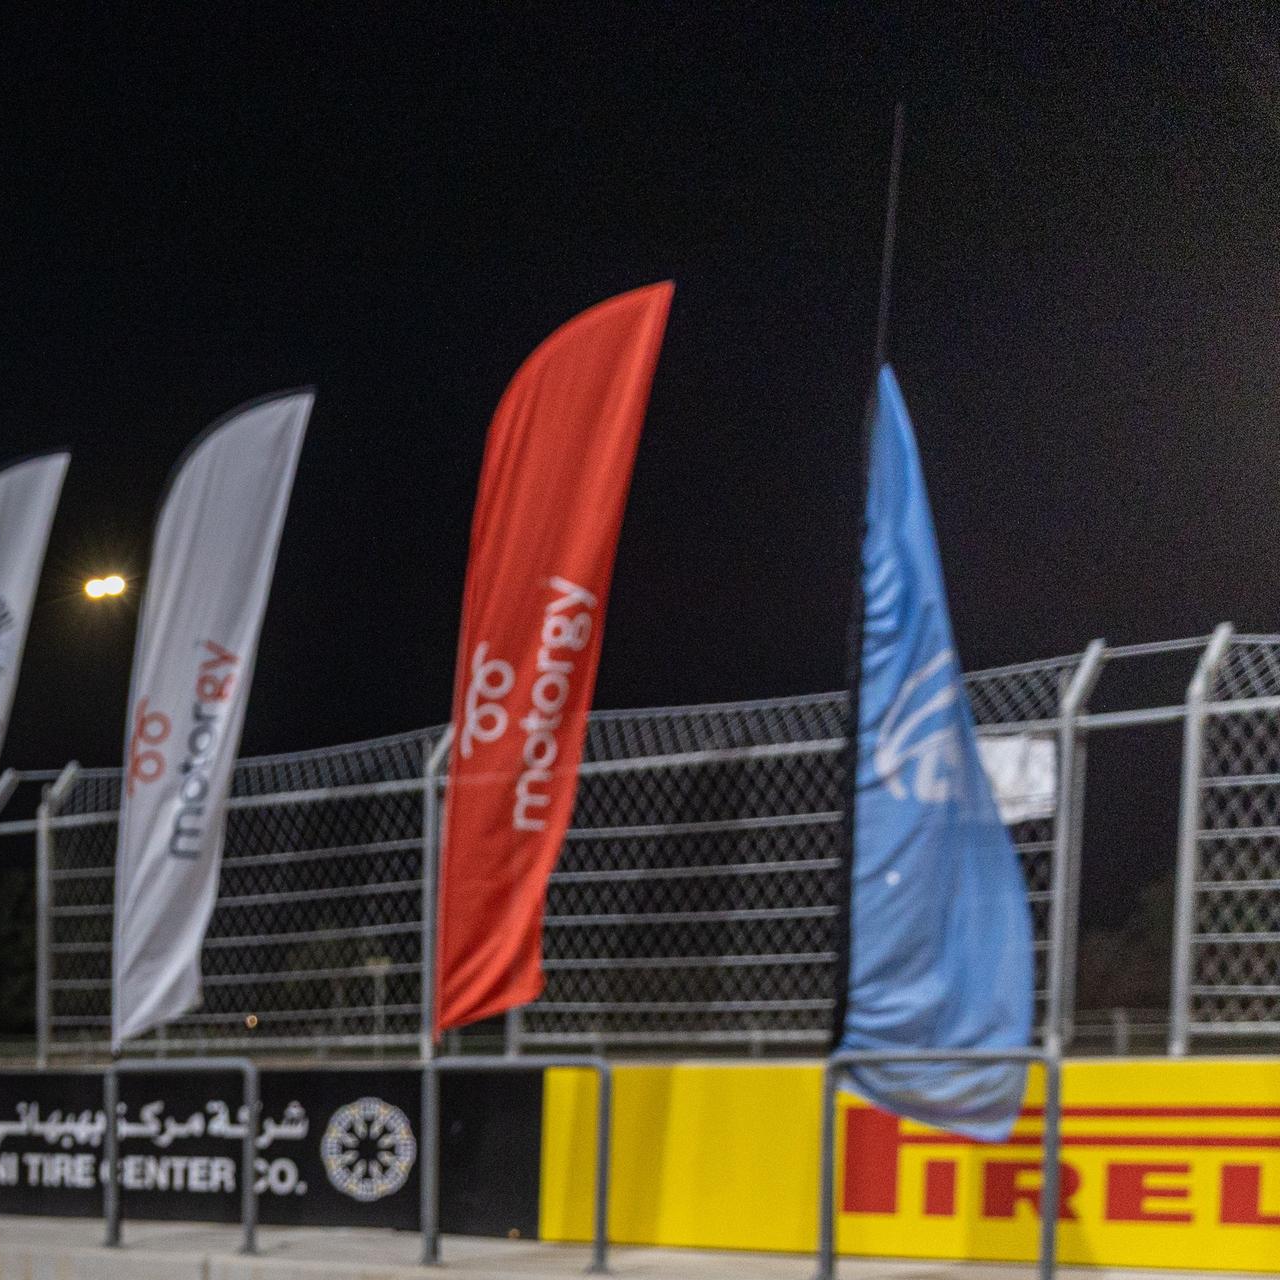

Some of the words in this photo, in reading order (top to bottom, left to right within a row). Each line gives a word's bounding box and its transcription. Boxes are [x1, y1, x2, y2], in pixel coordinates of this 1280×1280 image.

[167, 638, 239, 862] motorgy
[512, 575, 598, 833] motorgy
[22, 1152, 96, 1189] TIRE
